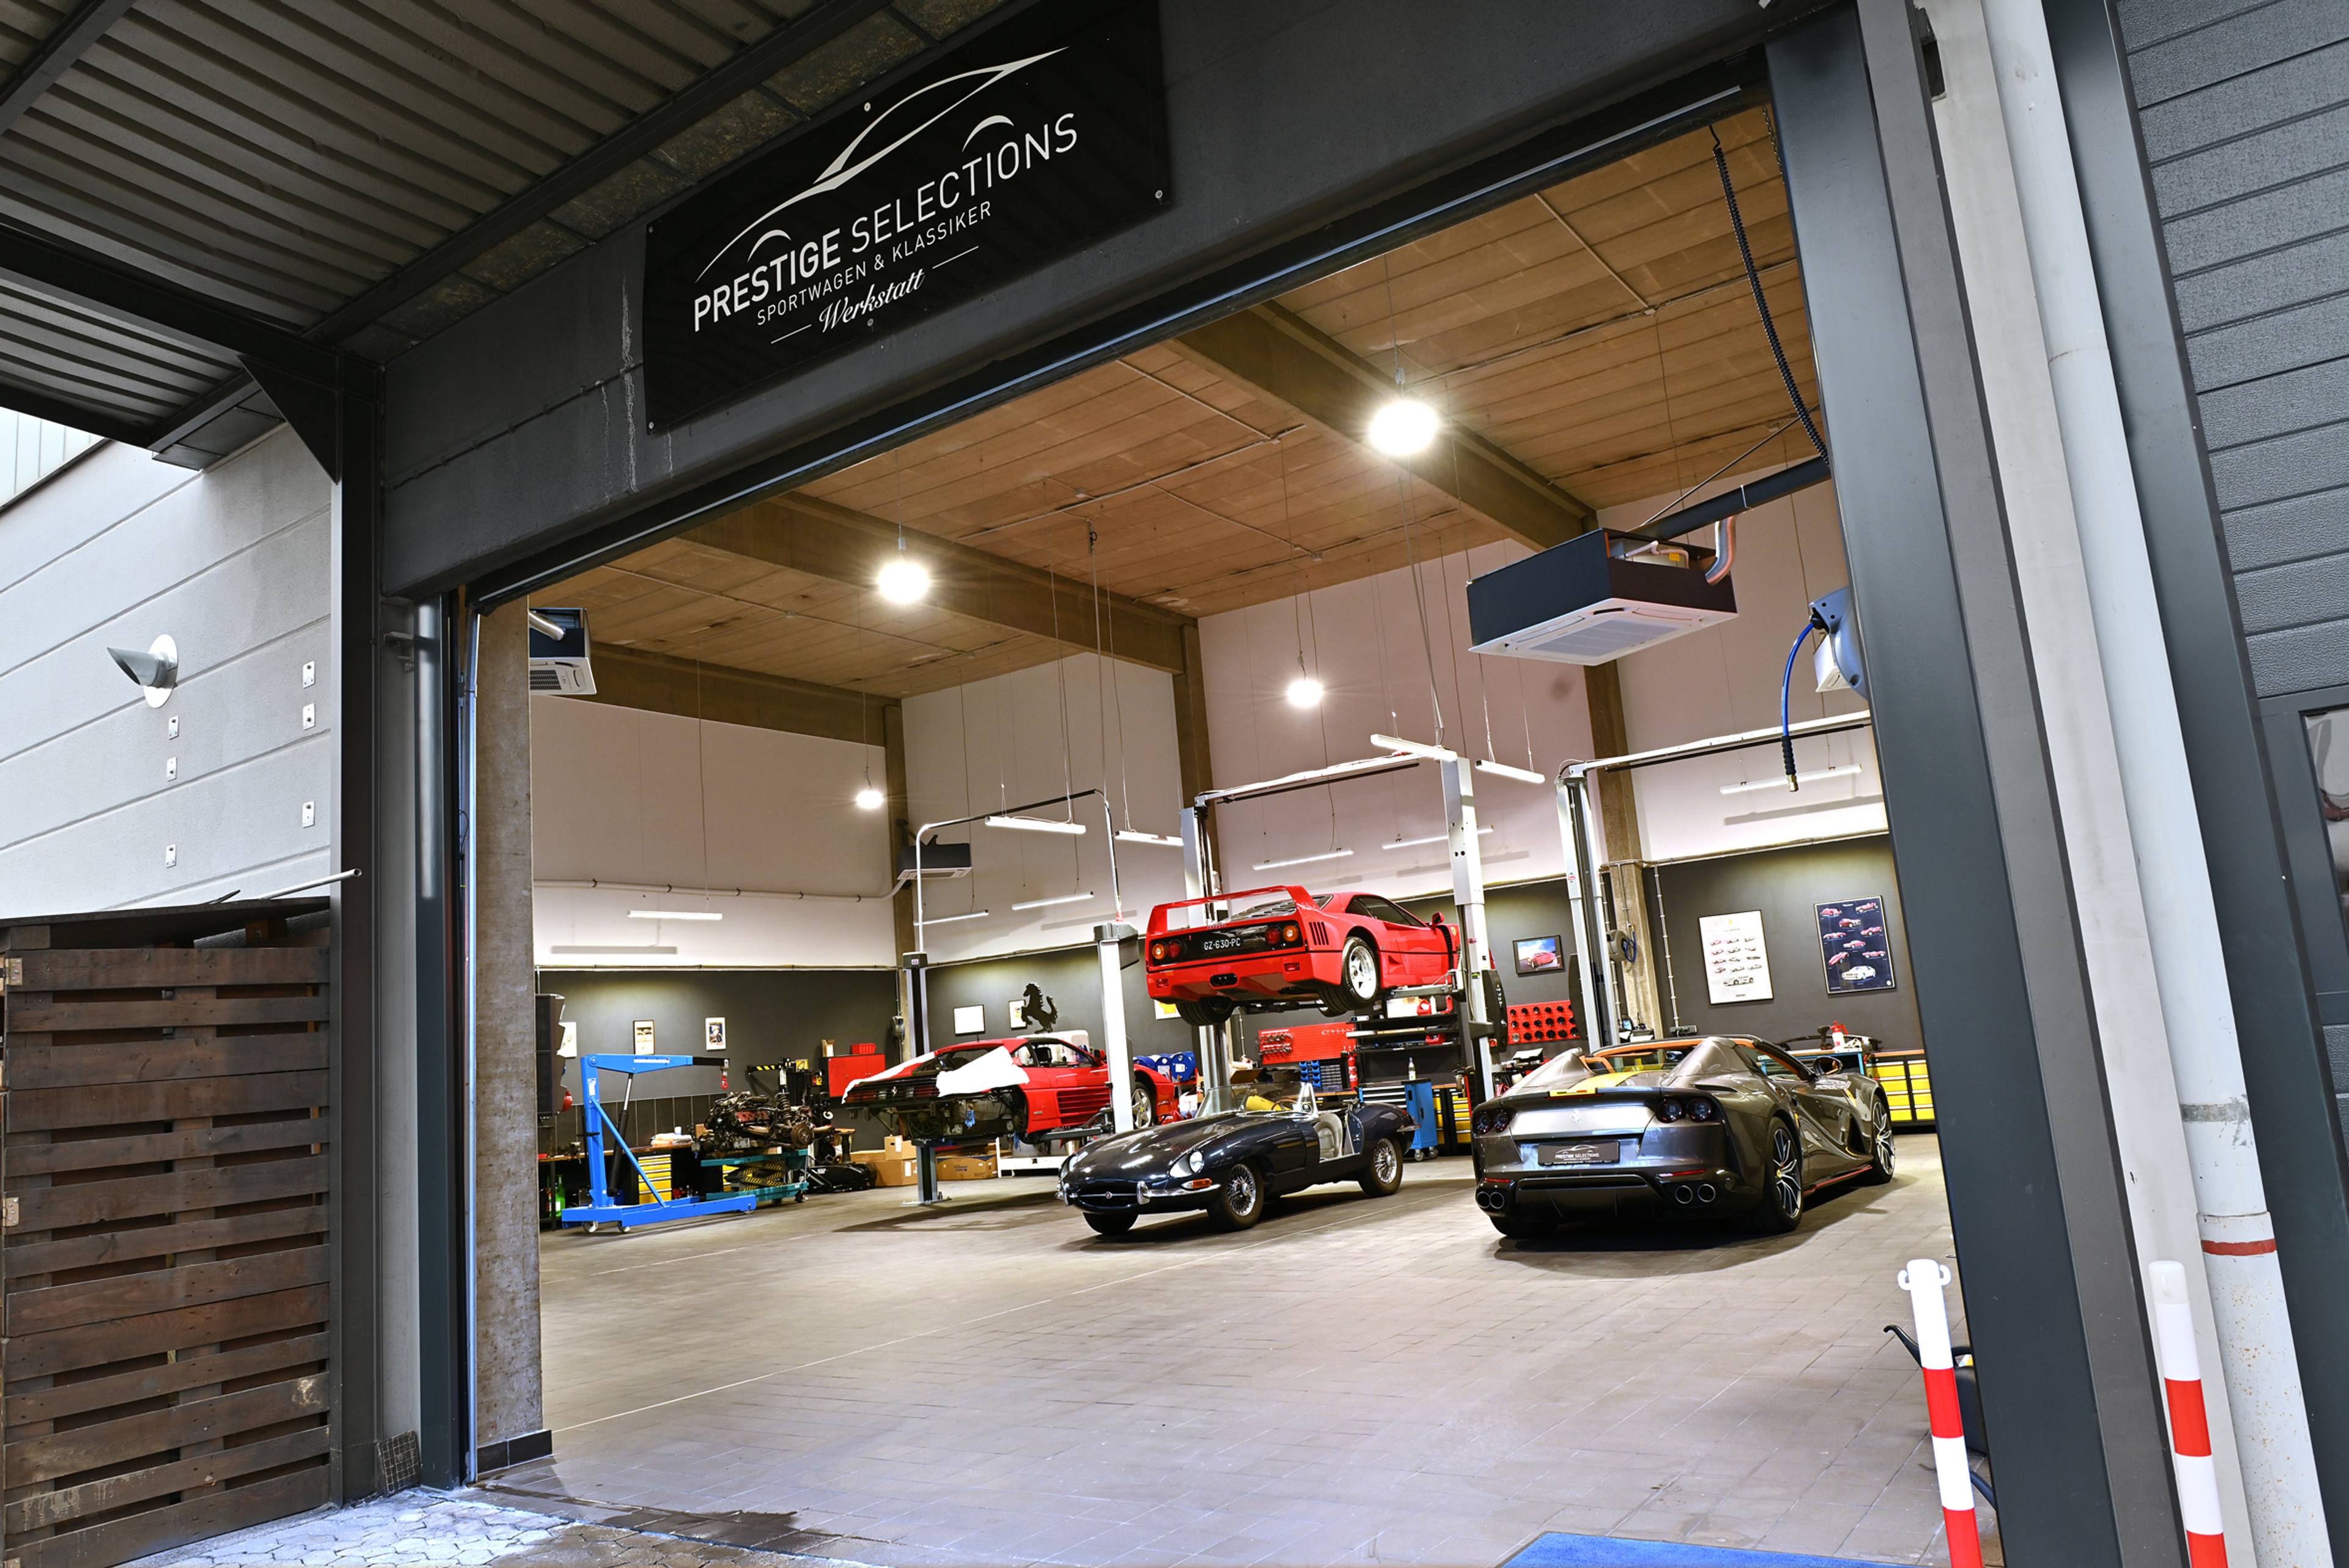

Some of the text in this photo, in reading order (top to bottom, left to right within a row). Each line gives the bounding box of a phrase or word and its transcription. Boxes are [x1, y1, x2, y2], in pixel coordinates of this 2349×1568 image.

[694, 113, 1077, 332] PRESTIGE SELECTIONS
[757, 201, 991, 325] SPORTWAGEN & KLASSIKER
[818, 268, 926, 333] Werkstatt
